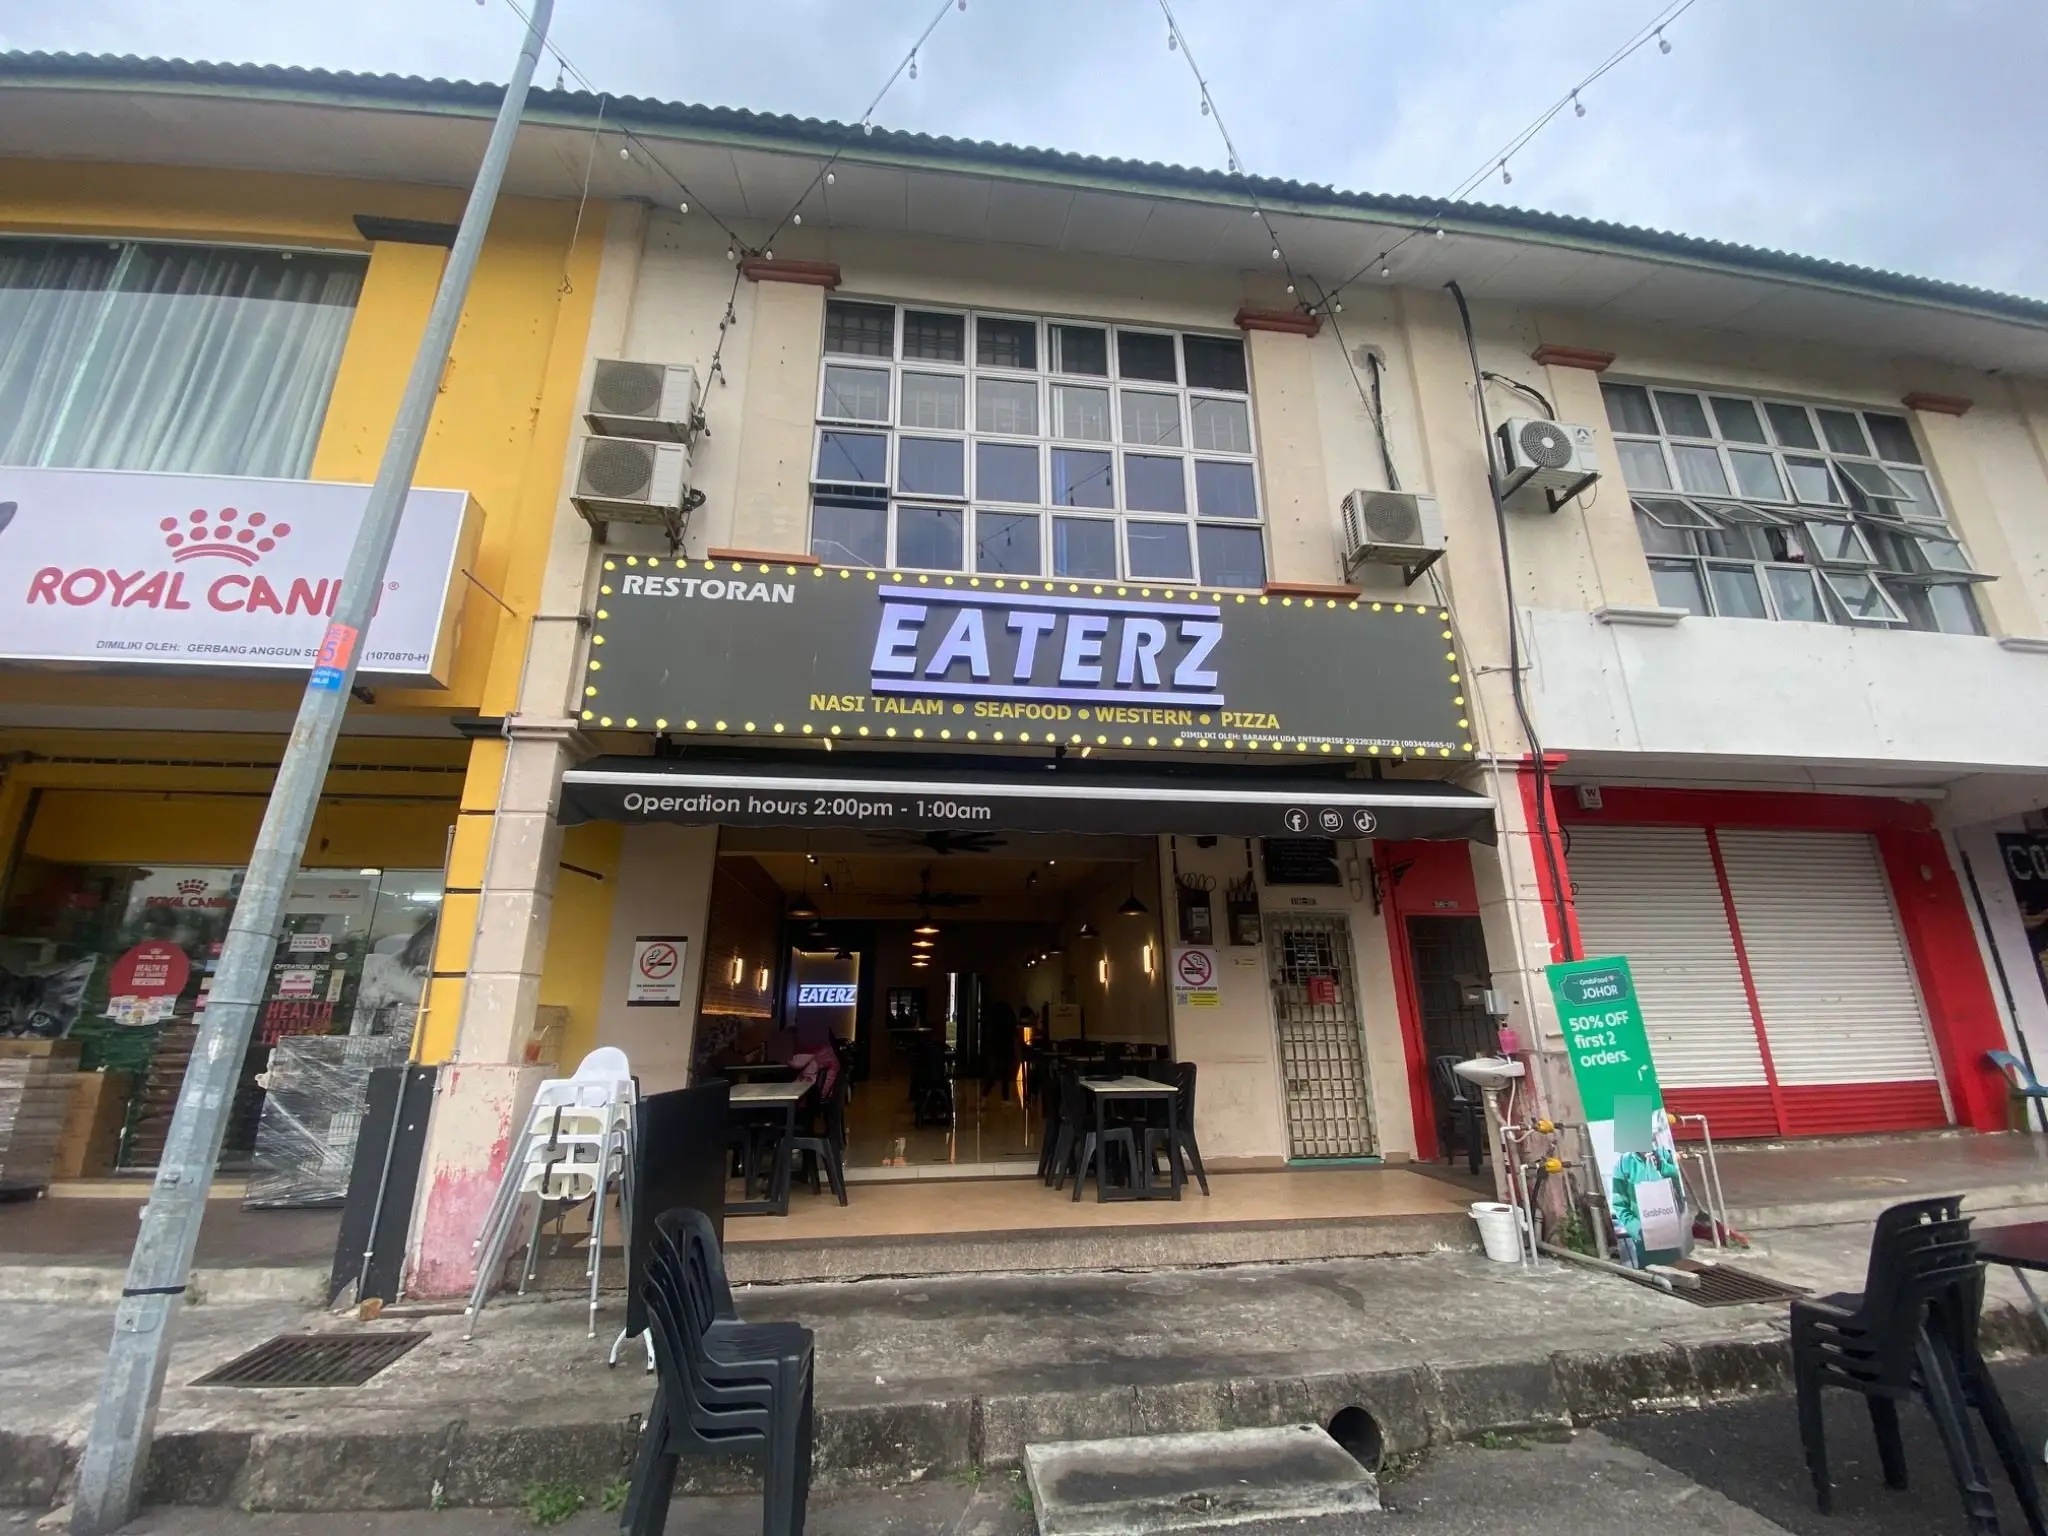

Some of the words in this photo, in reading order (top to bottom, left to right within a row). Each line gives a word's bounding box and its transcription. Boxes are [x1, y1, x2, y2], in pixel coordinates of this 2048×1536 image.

[26, 566, 192, 610] ROYAL
[207, 574, 384, 618] CANI
[621, 574, 796, 604] RESTORAN
[96, 640, 143, 650] DIMILIKI
[145, 642, 181, 652] OLEH:
[187, 643, 247, 655] GERBANG
[249, 646, 302, 657] ANGGUN
[366, 651, 429, 663] (1070870-H)
[870, 601, 1223, 688] EATERZ
[809, 693, 865, 713] NASI
[872, 695, 944, 715] TALAM
[974, 700, 1072, 720] SEAFOOD
[1095, 705, 1193, 726] WESTERN
[1221, 711, 1280, 730] PIZZA
[1180, 731, 1217, 740] DIMILIKI
[1242, 733, 1279, 742] BARAKAH
[1280, 735, 1297, 743] UDA
[1297, 735, 1344, 745] ENTERPRISE
[623, 792, 741, 815] Operation
[748, 795, 808, 815] hours
[813, 798, 893, 819] 2:00pm
[916, 800, 991, 821] 1:00am
[799, 988, 857, 1002] EATERZ
[1582, 985, 1618, 999] JOHOR
[1569, 1014, 1604, 1031] 50%
[1605, 1010, 1630, 1026] OFF
[1574, 1033, 1606, 1049] first
[1606, 1031, 1616, 1045] 2
[1580, 1050, 1631, 1067] orders.
